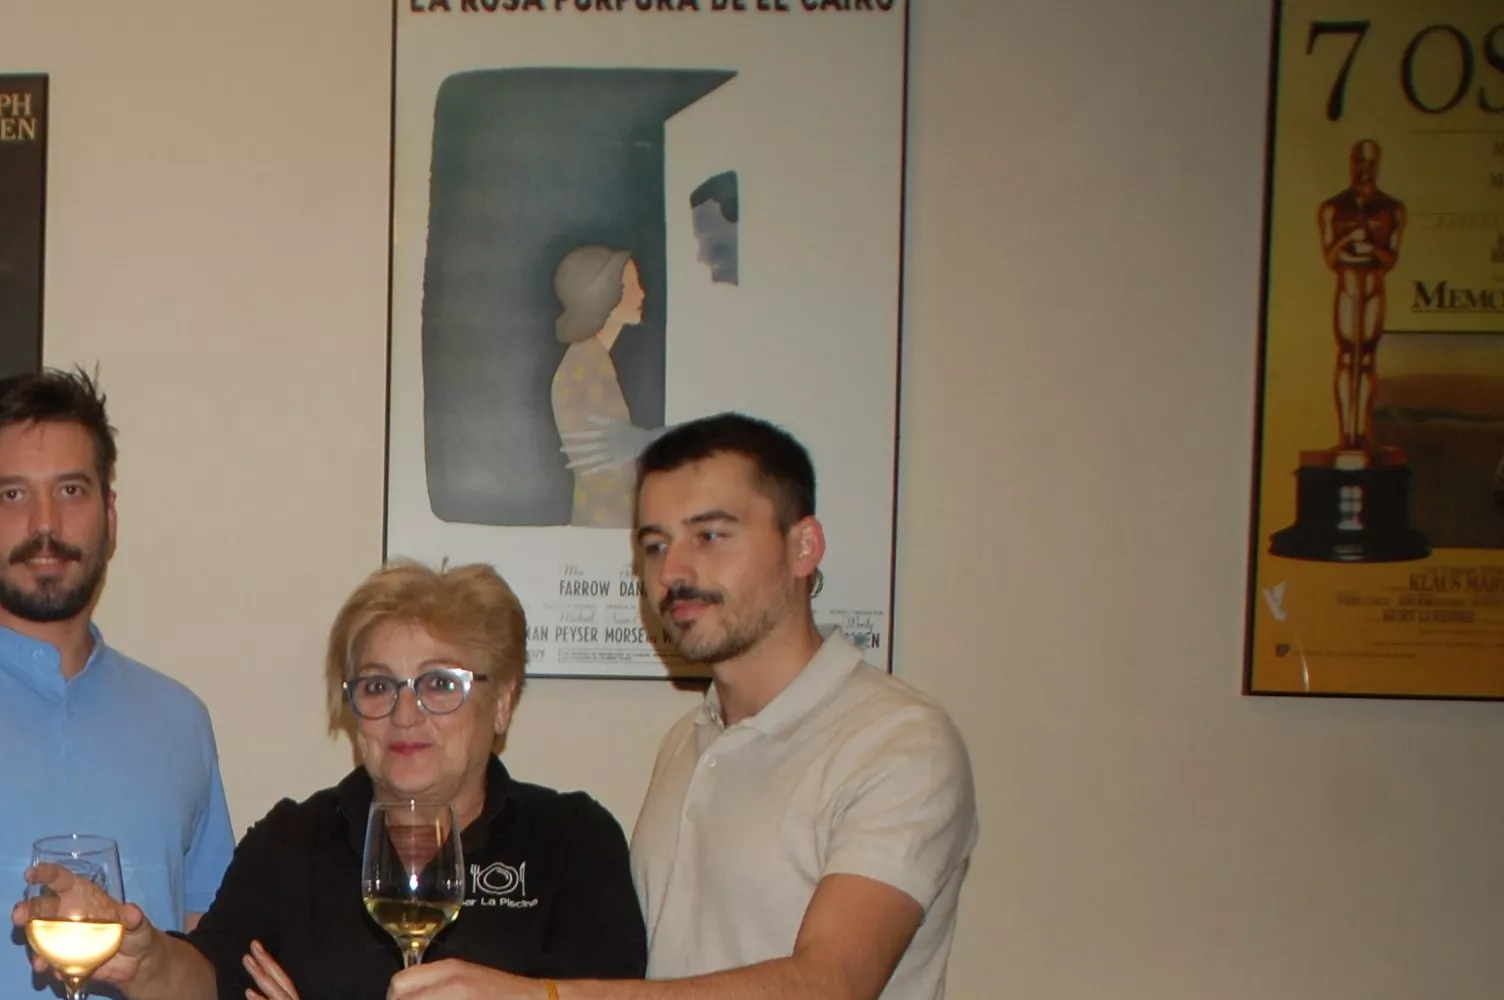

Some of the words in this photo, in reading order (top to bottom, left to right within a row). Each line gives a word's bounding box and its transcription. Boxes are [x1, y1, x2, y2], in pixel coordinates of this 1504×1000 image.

[1306, 20, 1370, 121] 7
[559, 579, 611, 597] FARROW
[619, 580, 647, 597] DAN
[555, 625, 599, 643] PEYSER
[481, 897, 496, 906] La
